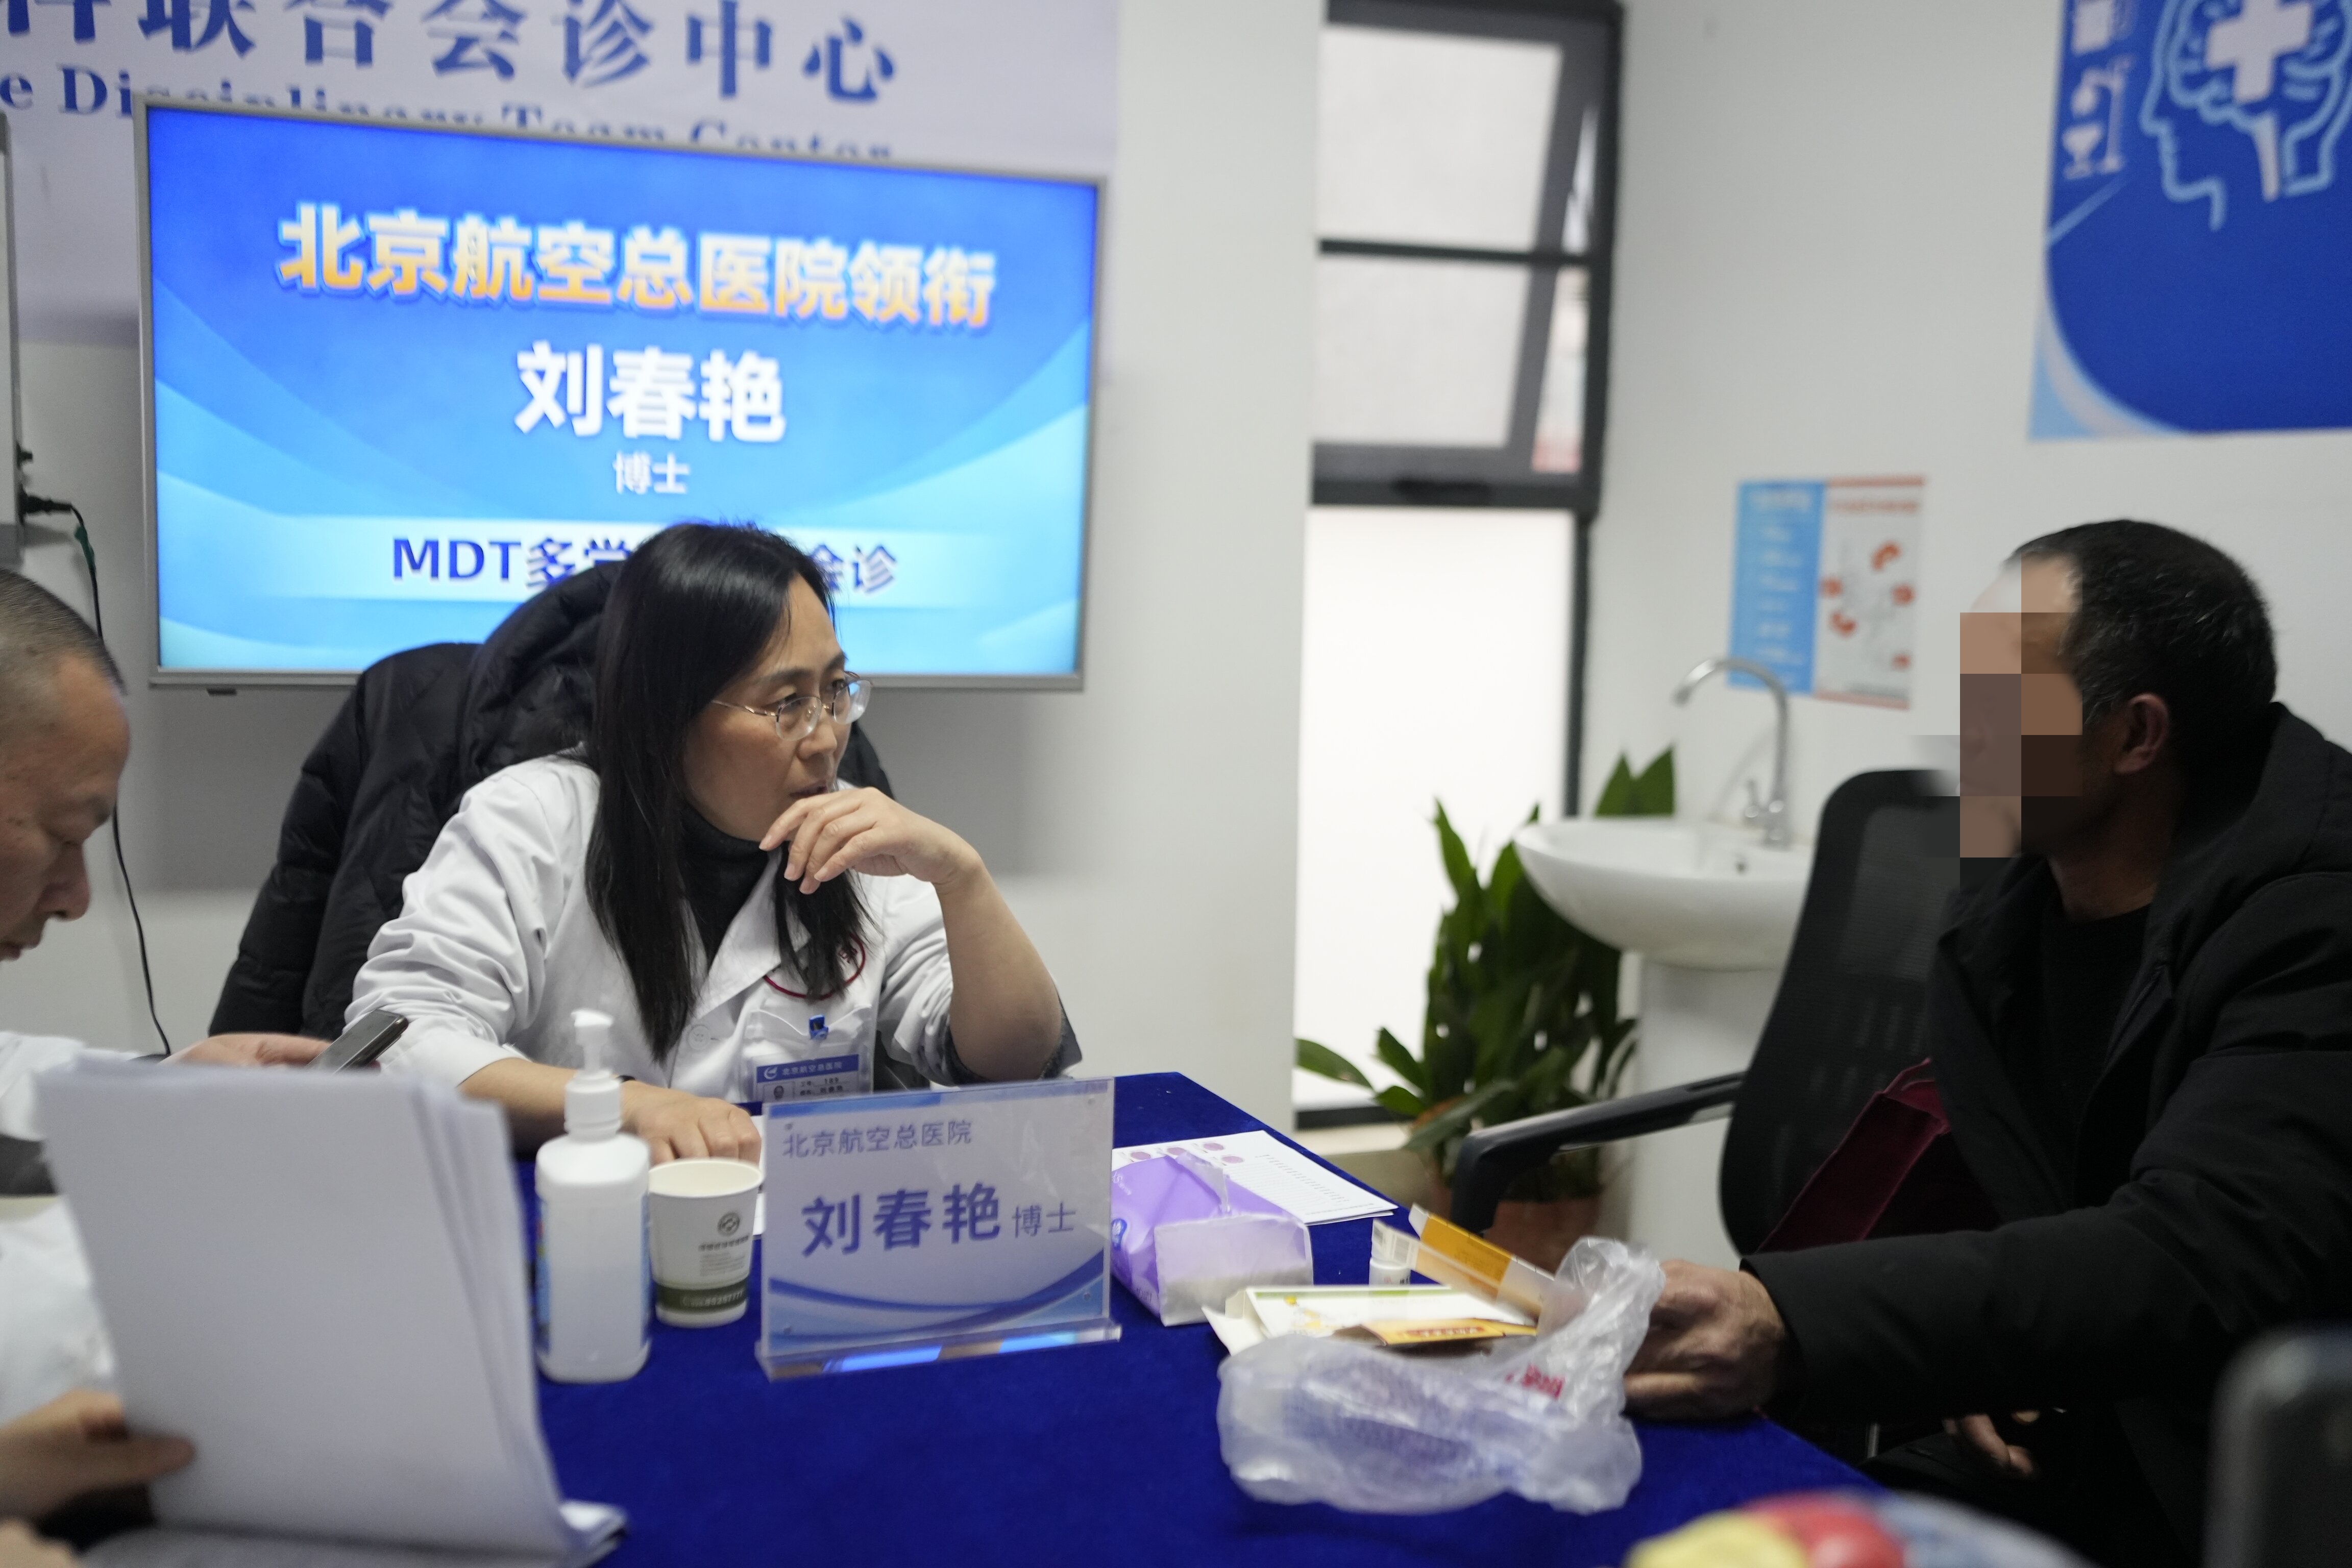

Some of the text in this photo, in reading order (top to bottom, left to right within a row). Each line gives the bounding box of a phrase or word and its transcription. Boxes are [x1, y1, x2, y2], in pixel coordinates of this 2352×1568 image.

[280, 203, 996, 329] 北京航空总医院领衔
[513, 340, 786, 443] 刘春艳
[612, 450, 690, 495] 博士
[782, 1119, 972, 1159] 北京航空总医院
[801, 1182, 1076, 1258] 刘春艳 博士
